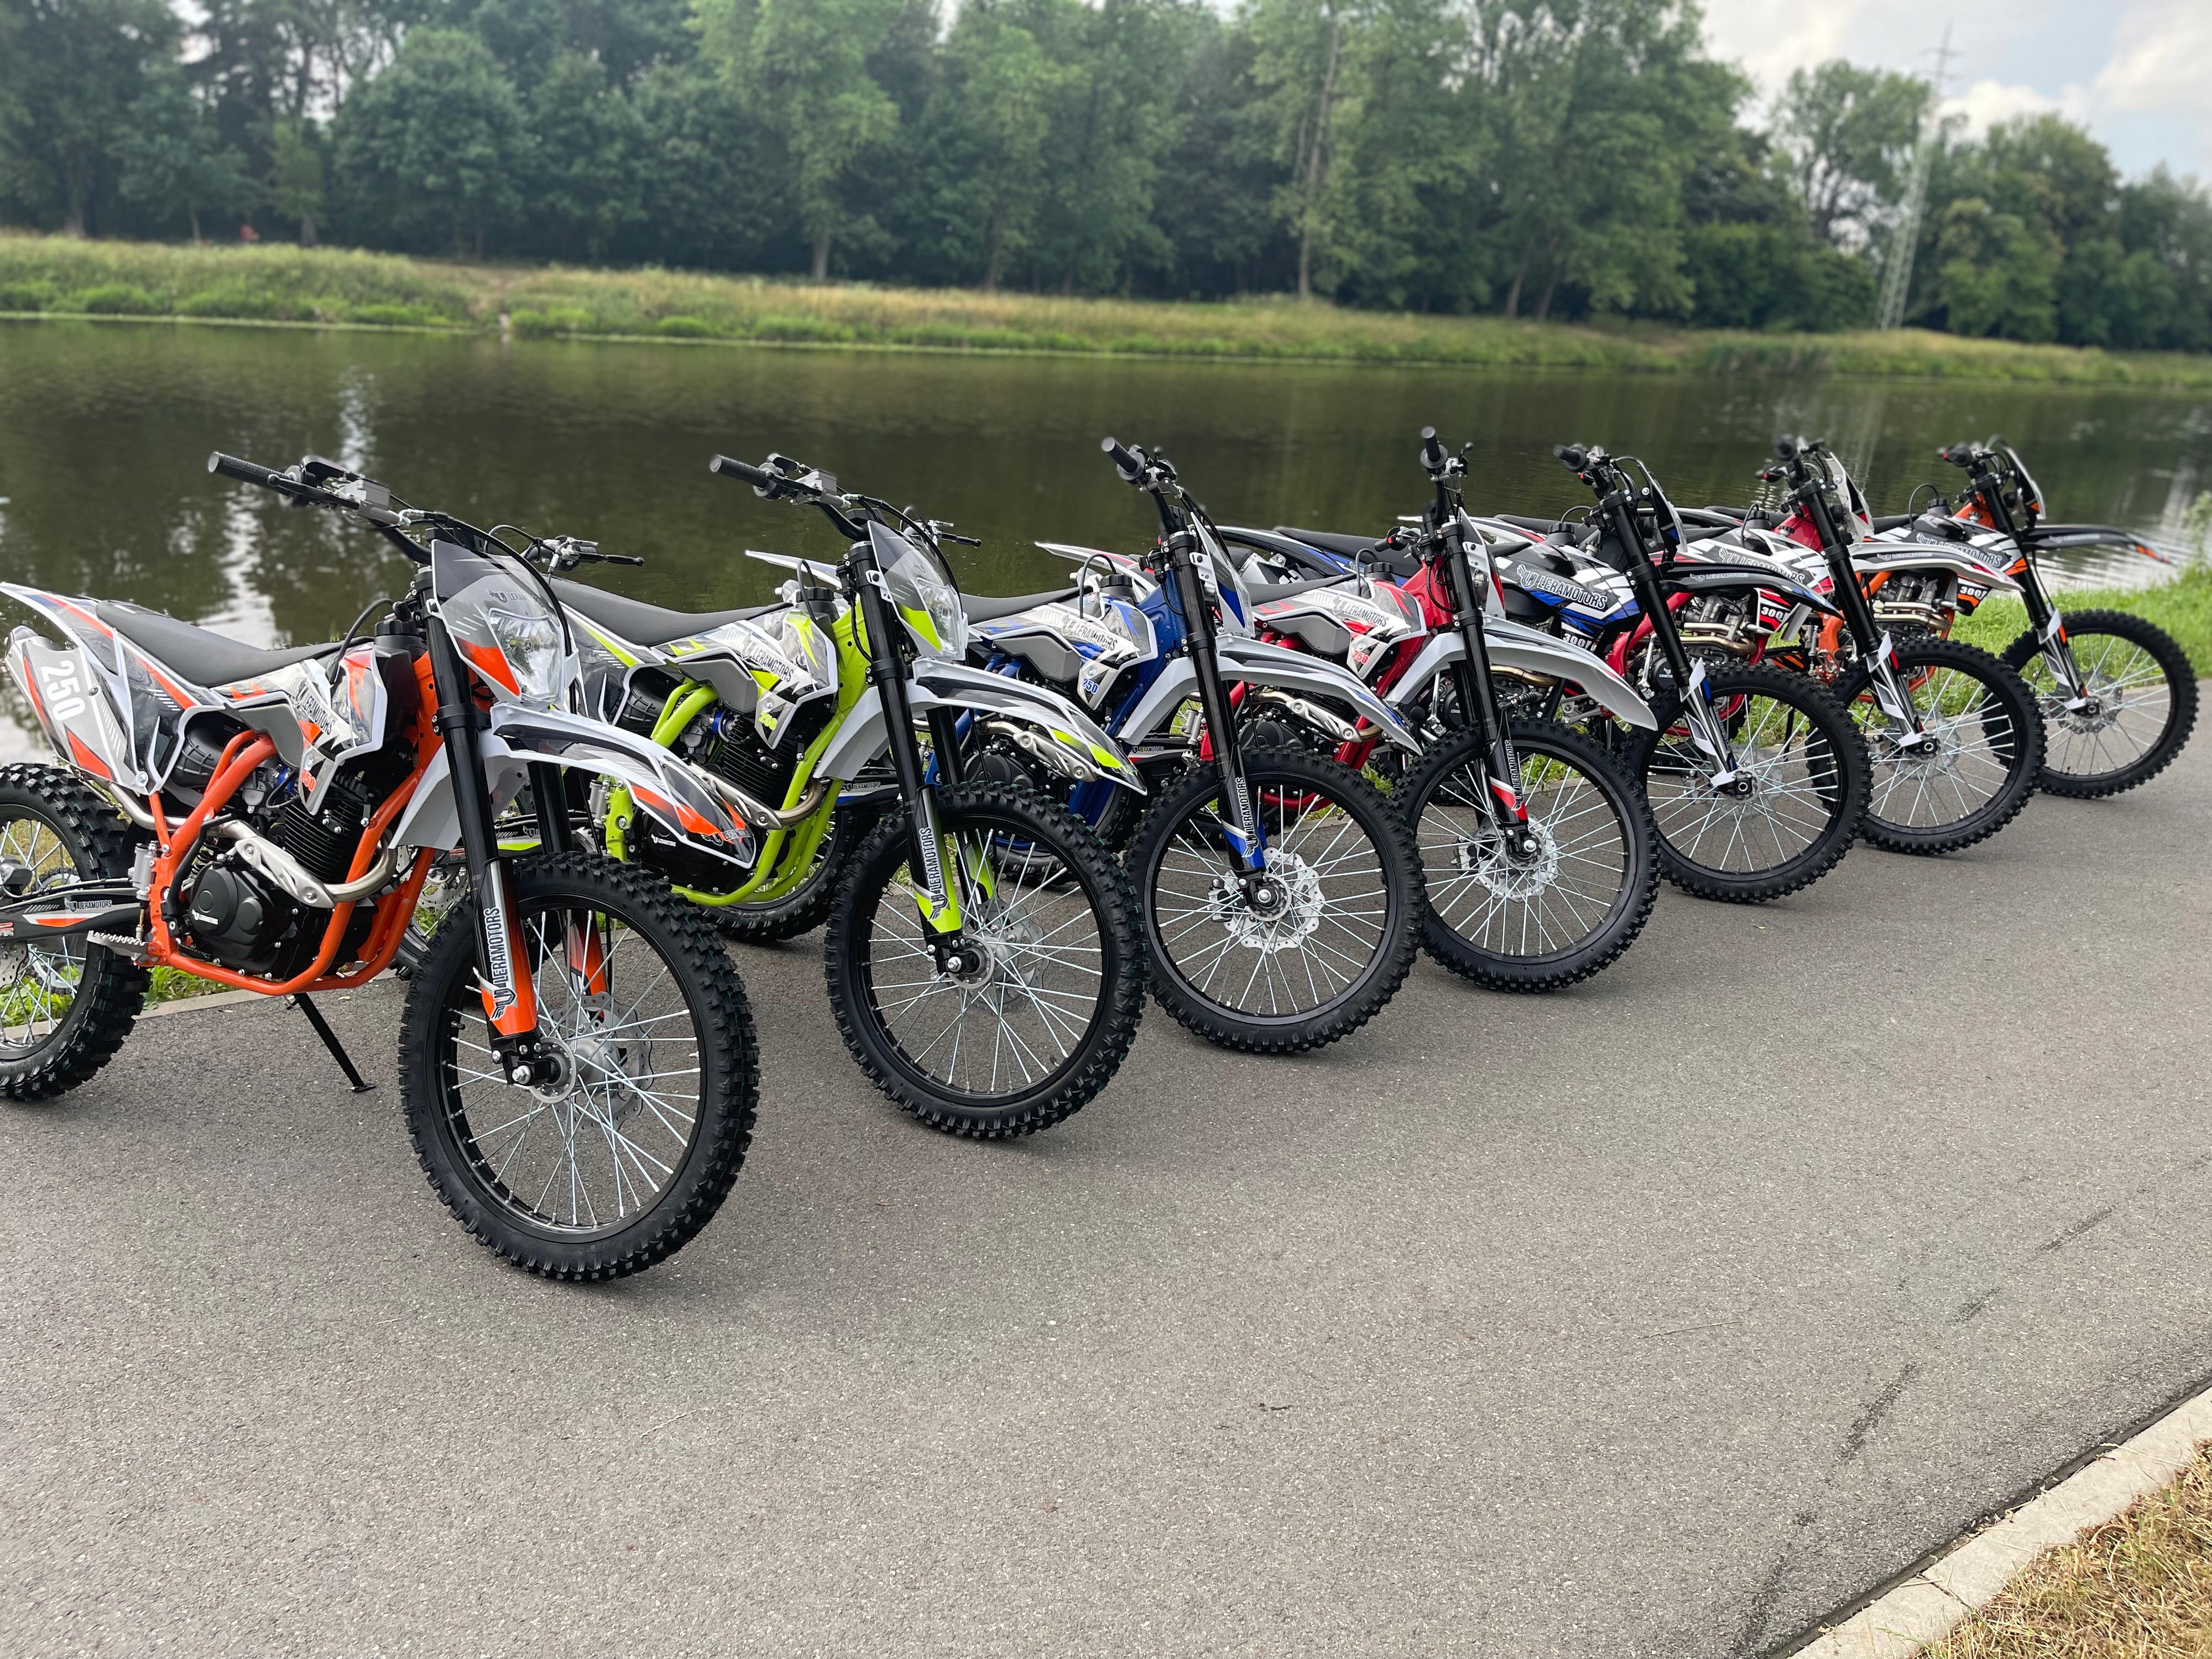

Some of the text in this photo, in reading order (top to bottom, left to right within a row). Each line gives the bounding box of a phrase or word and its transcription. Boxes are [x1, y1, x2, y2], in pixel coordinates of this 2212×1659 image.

[1537, 576, 1607, 609] LERAMOTORS
[1345, 603, 1389, 627] LERAMOTORS
[1074, 624, 1118, 651] LERAMOTORS
[752, 648, 794, 682] LERAMOTORS
[1352, 650, 1369, 664] 250
[40, 660, 85, 721] 250
[1083, 678, 1099, 694] 250
[303, 693, 332, 735] LERAMOTORS
[301, 769, 316, 791] 250
[1235, 777, 1255, 832] LERAMOTORS
[919, 827, 942, 891] LERAMOTORS
[79, 900, 112, 909] LERAMOTORS
[484, 907, 509, 985] LERAMOTORS
